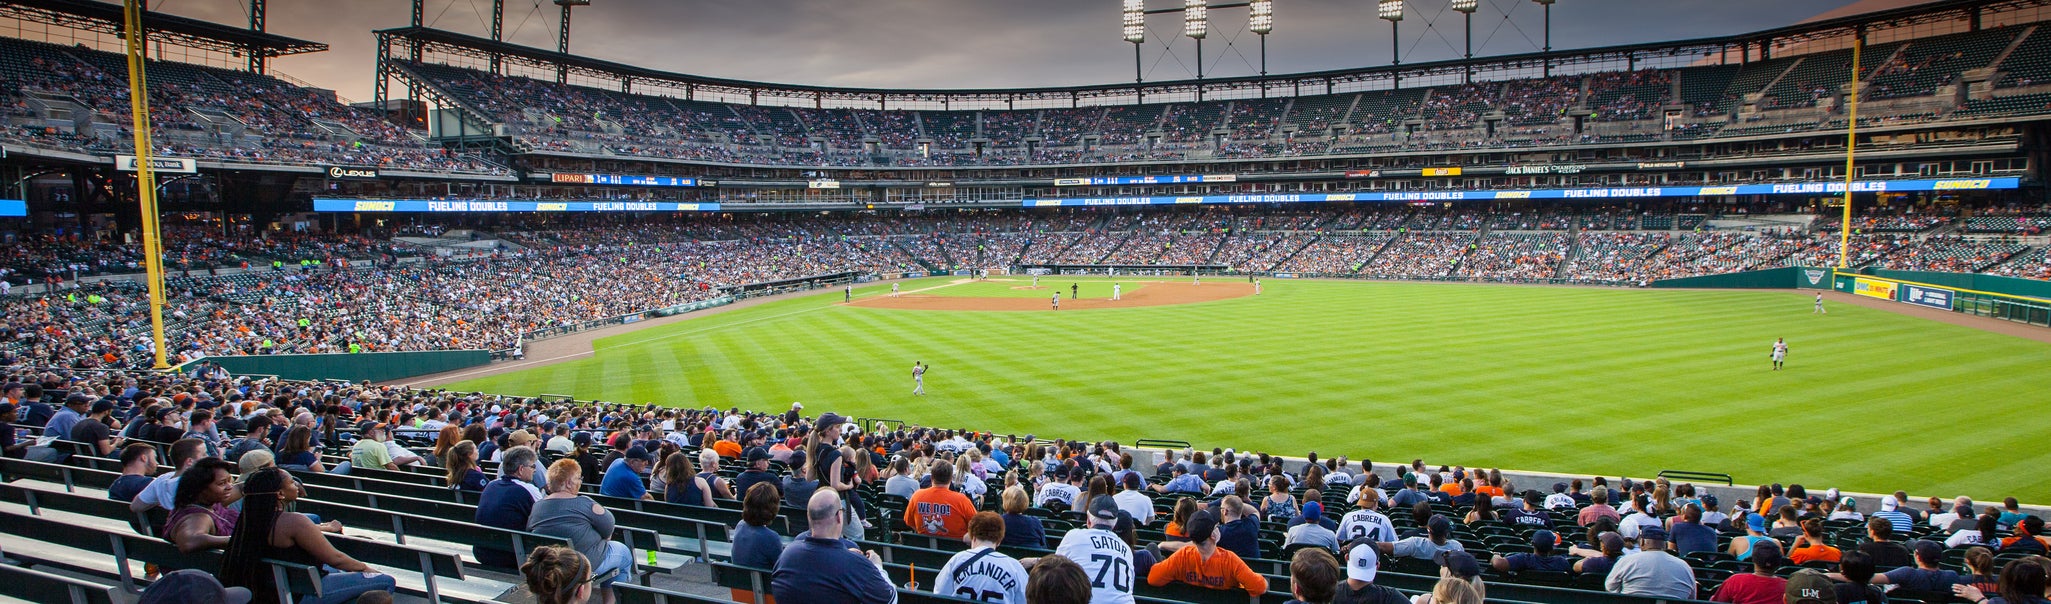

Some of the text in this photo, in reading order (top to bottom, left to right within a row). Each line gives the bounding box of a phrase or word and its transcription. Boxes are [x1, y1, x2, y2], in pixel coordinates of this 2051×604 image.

[1506, 166, 1549, 174] JACK DANIEL'S
[557, 174, 582, 182] LIPARI
[1264, 194, 1300, 202] DOUBLES
[1384, 192, 1422, 200] FUELING
[1423, 192, 1464, 200] DOUBLES
[1494, 190, 1531, 198] SUNOCO
[1564, 190, 1609, 198] FUELING
[1611, 188, 1662, 197] DOUBLES
[1698, 186, 1738, 196] SUNOCO
[1773, 184, 1823, 194] FUELING
[1826, 182, 1886, 192] DOUBLES
[1933, 180, 1991, 190] SUNOCO
[354, 201, 396, 211] SUNOCO
[428, 201, 468, 211] FUELING
[470, 202, 508, 211] DOUBLES
[536, 202, 568, 211] SUNOCO
[593, 202, 624, 211] FUELING
[626, 202, 656, 210] DOUBLES
[1045, 488, 1072, 501] CABRERA
[918, 502, 951, 516] WE DO!
[1352, 514, 1382, 526] CABRERA
[1516, 516, 1545, 526] CABRERA
[1090, 536, 1128, 558] GATOR
[1091, 554, 1130, 594] 70
[1801, 588, 1820, 598] U-M
